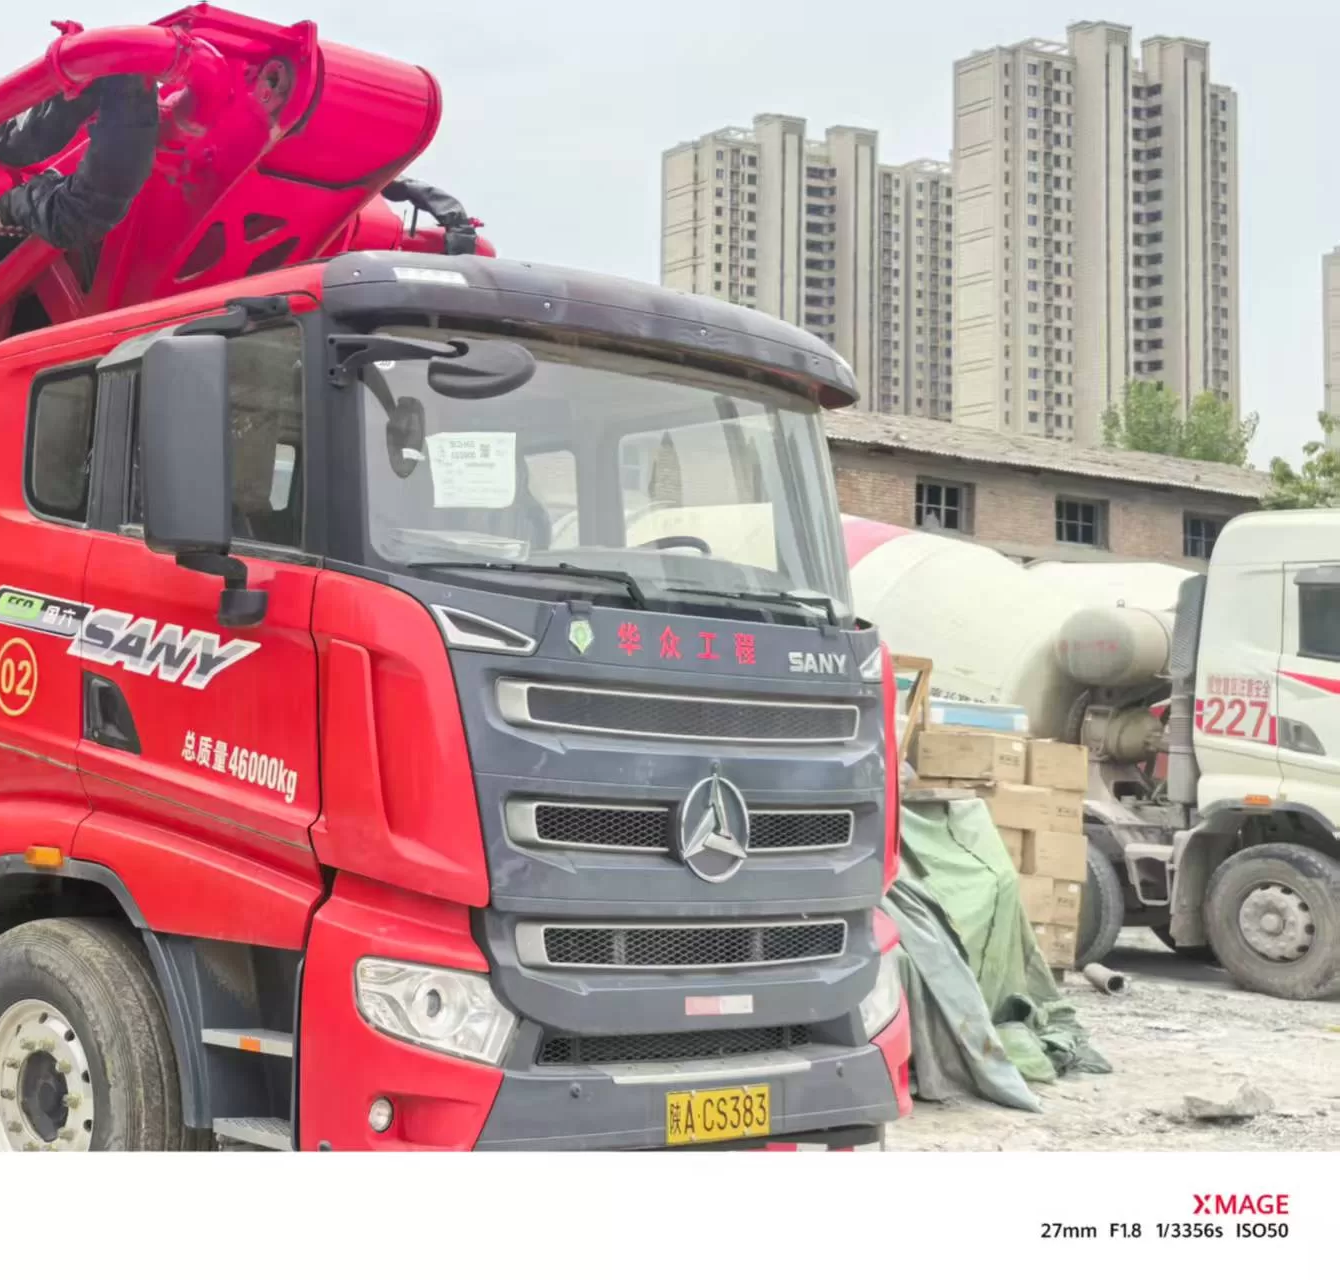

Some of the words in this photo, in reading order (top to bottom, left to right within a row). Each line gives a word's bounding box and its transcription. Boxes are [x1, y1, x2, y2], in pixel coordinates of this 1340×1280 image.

[68, 608, 261, 690] SANY
[617, 622, 757, 665] 华众工程
[788, 652, 847, 674] SANY
[1, 658, 32, 696] 02
[1204, 697, 1268, 738] 227
